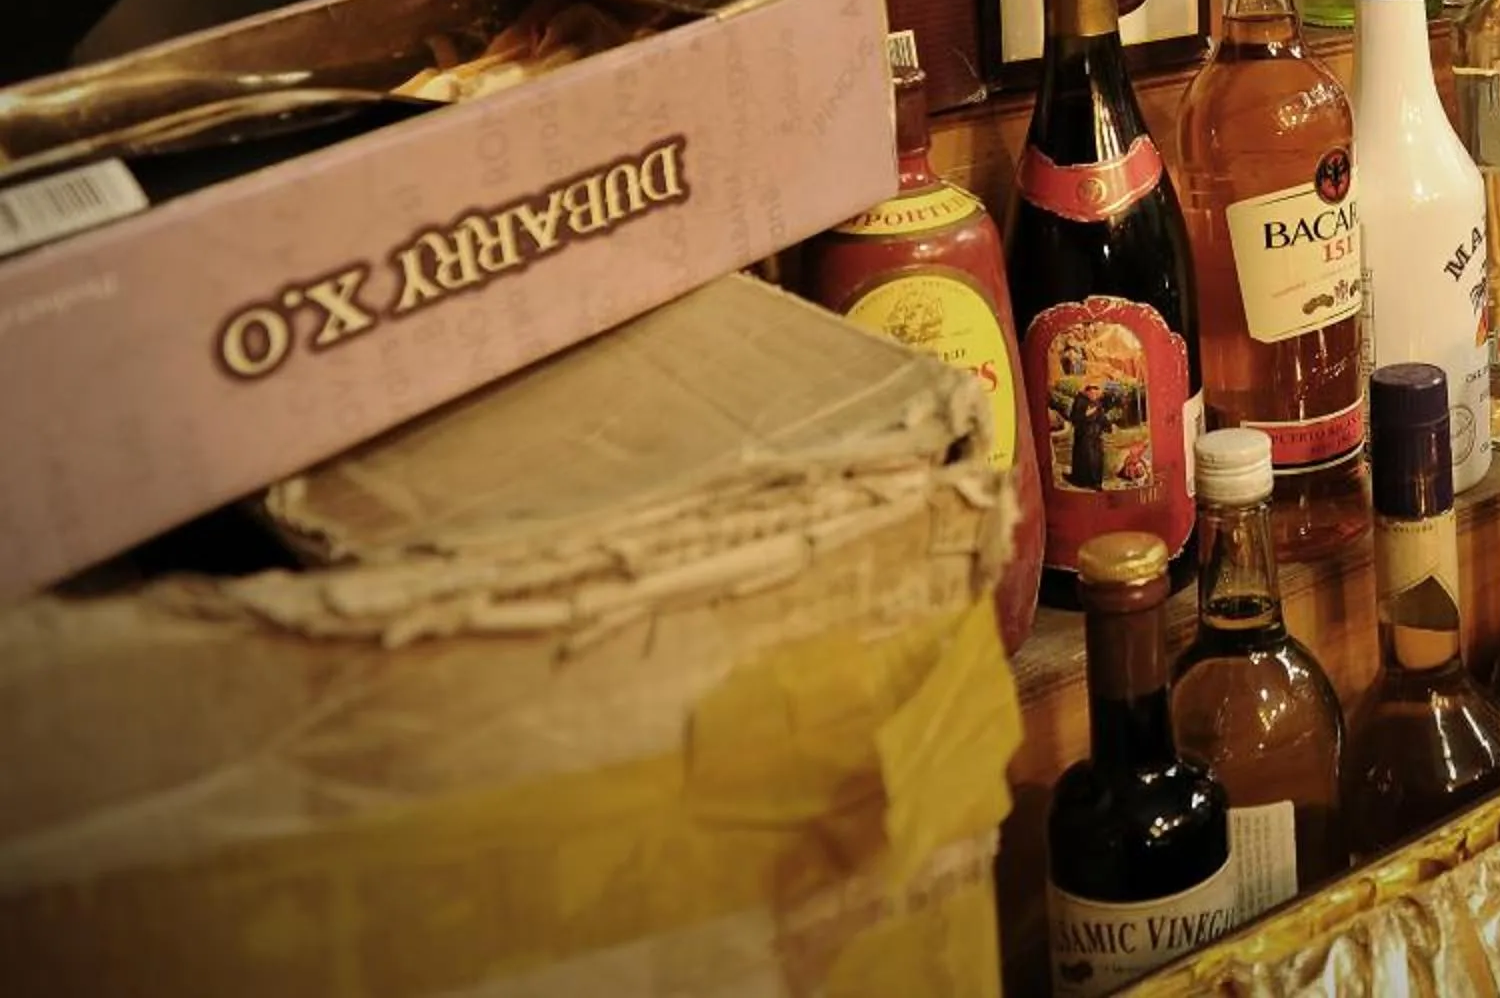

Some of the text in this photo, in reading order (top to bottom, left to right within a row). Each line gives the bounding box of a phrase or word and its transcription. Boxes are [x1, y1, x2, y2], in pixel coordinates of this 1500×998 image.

[394, 136, 690, 318] DUBARRY
[1263, 201, 1359, 251] BACAR
[1323, 234, 1354, 263] 151
